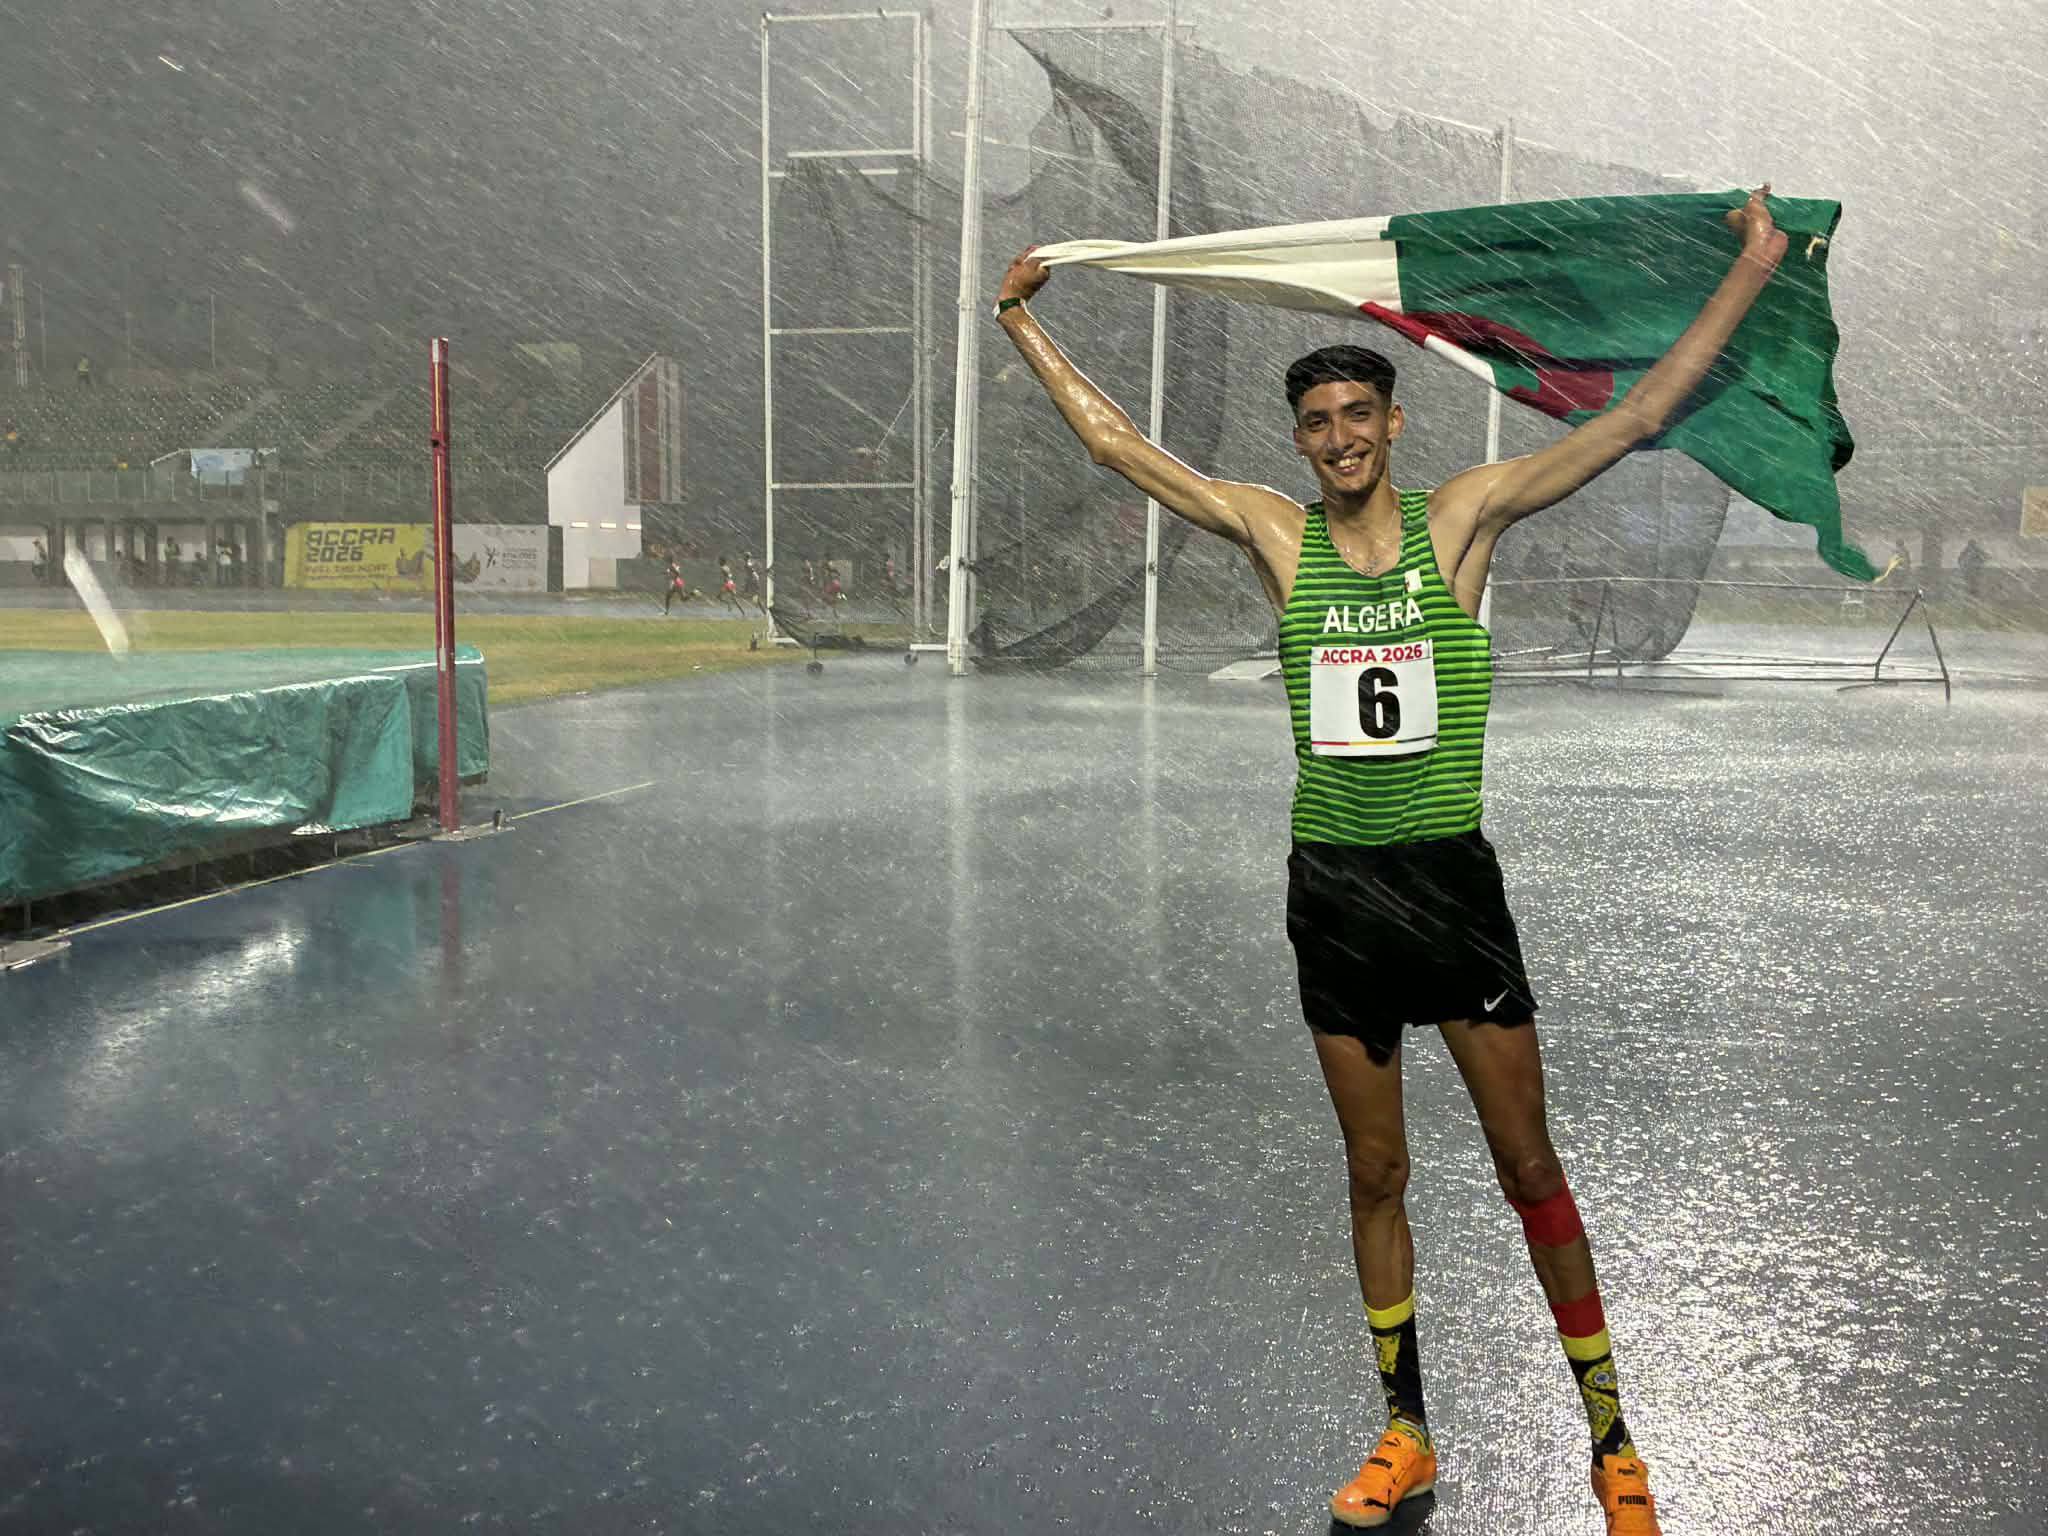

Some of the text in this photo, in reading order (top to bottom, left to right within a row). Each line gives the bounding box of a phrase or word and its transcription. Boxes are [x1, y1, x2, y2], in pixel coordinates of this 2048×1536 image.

[306, 528, 395, 546] ACCRA
[306, 546, 364, 562] 2026
[1321, 645, 1423, 664] ACCRA 2026
[1358, 667, 1401, 739] 6
